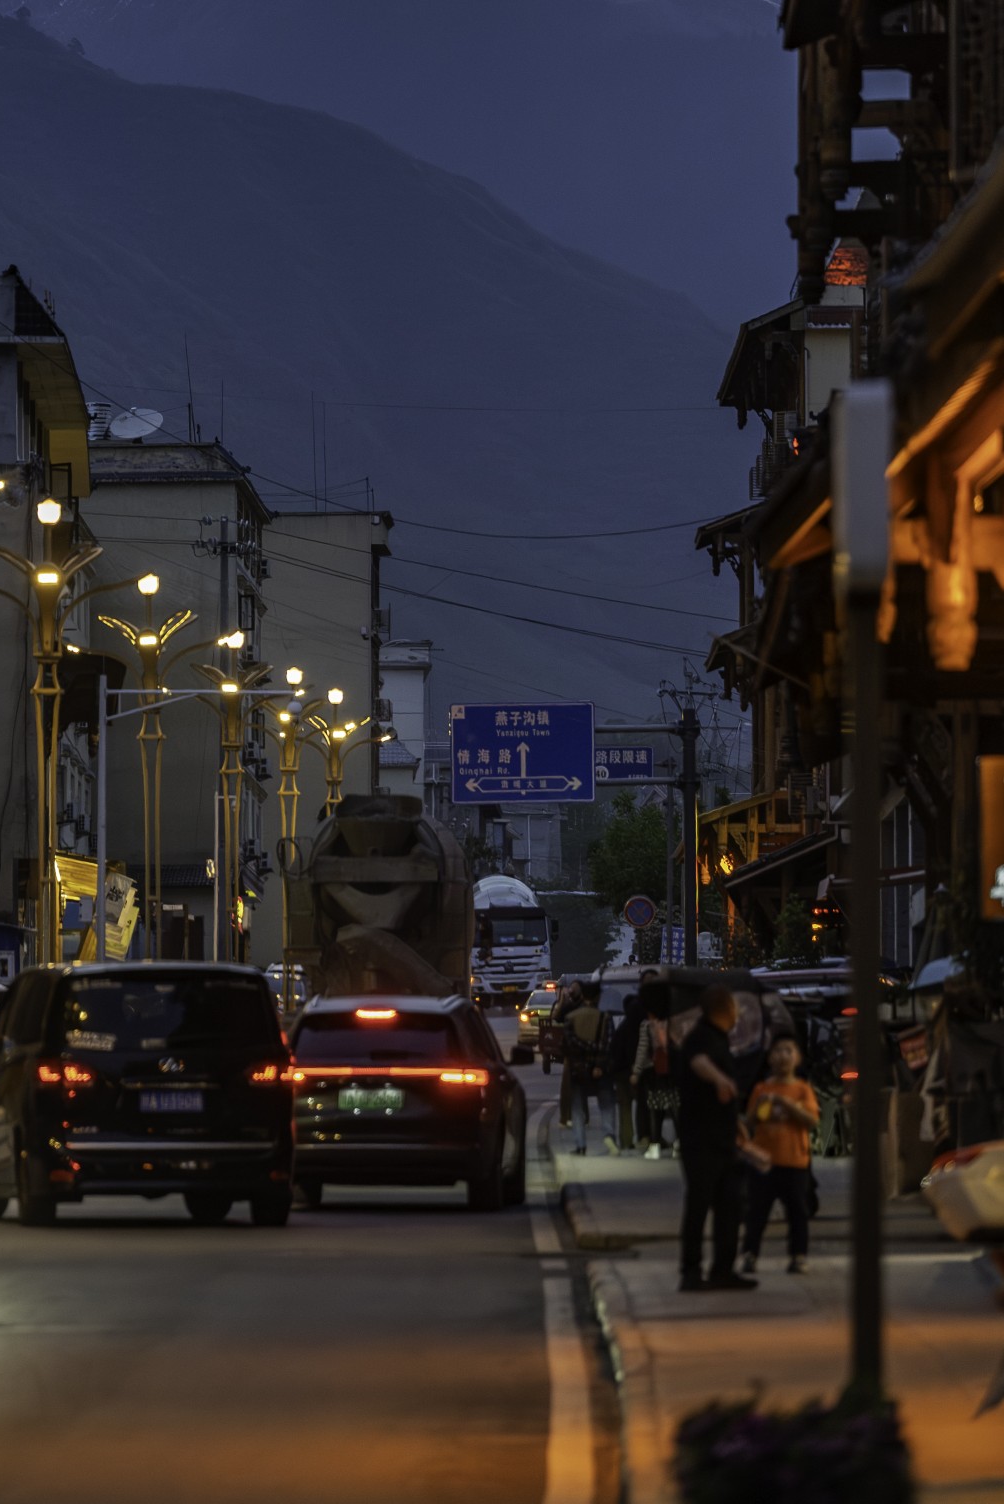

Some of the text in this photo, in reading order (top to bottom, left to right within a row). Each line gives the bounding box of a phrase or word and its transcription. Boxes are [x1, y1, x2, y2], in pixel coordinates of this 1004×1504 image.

[495, 710, 550, 726] 燕子沟镇
[496, 728, 550, 738] Yanzigou Town
[457, 748, 512, 765] 情海路
[596, 750, 647, 764] 路段限速
